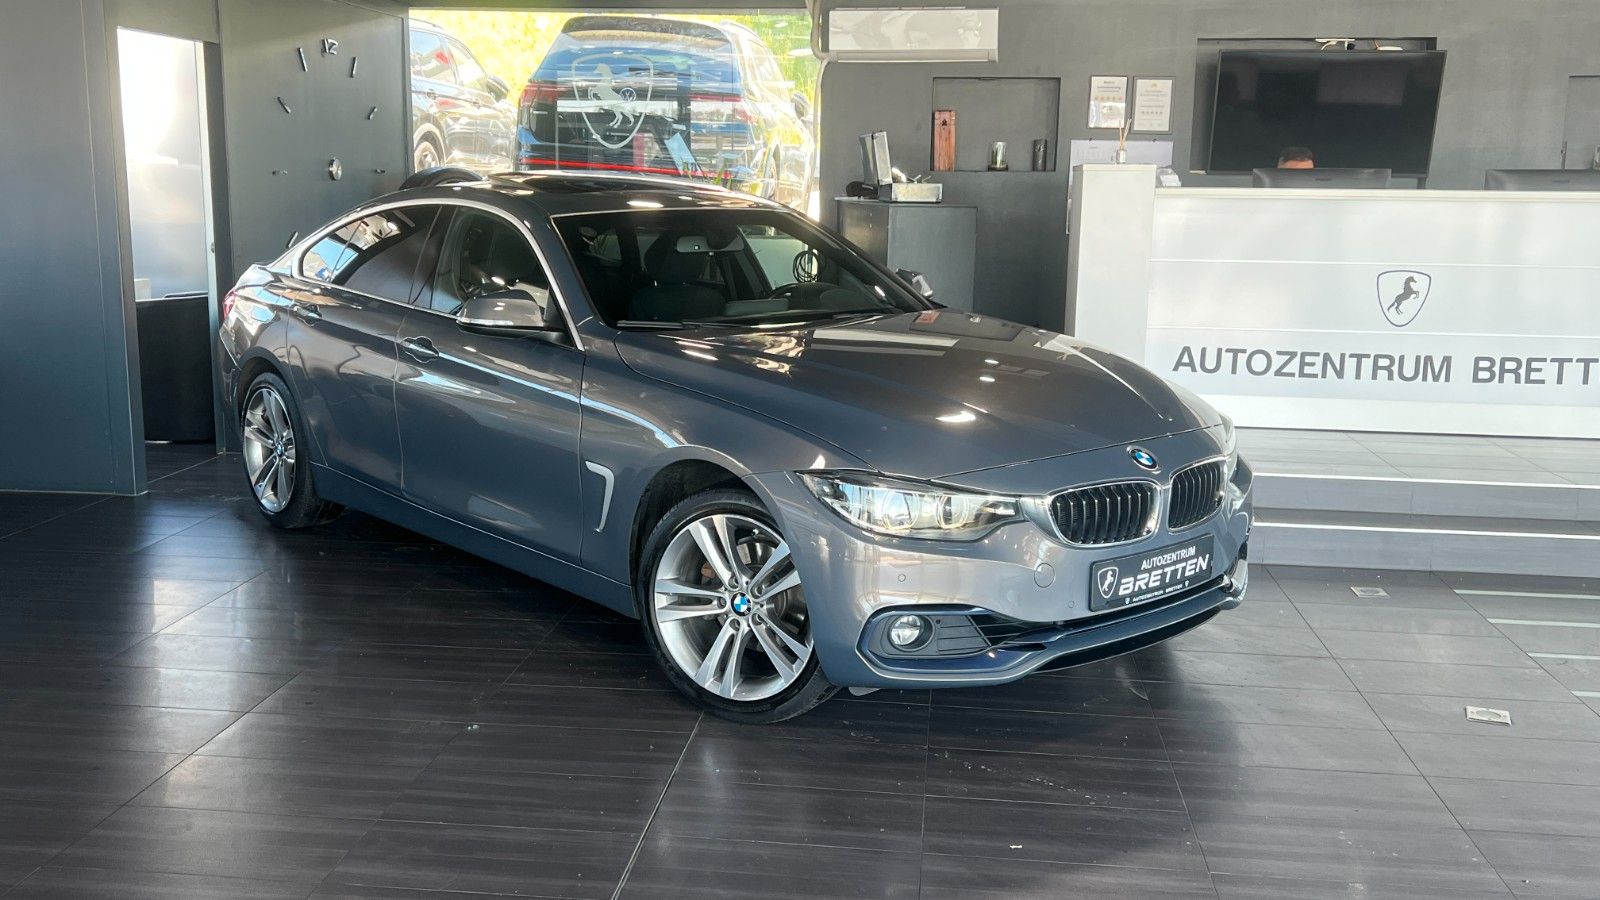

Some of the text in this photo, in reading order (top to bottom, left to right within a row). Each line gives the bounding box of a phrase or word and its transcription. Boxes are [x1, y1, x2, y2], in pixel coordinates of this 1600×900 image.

[1172, 345, 1600, 385] AUTOZENTRUM BRETT
[1118, 553, 1210, 596] BRETTEN
[1140, 545, 1196, 571] AUTOZENTRUM
